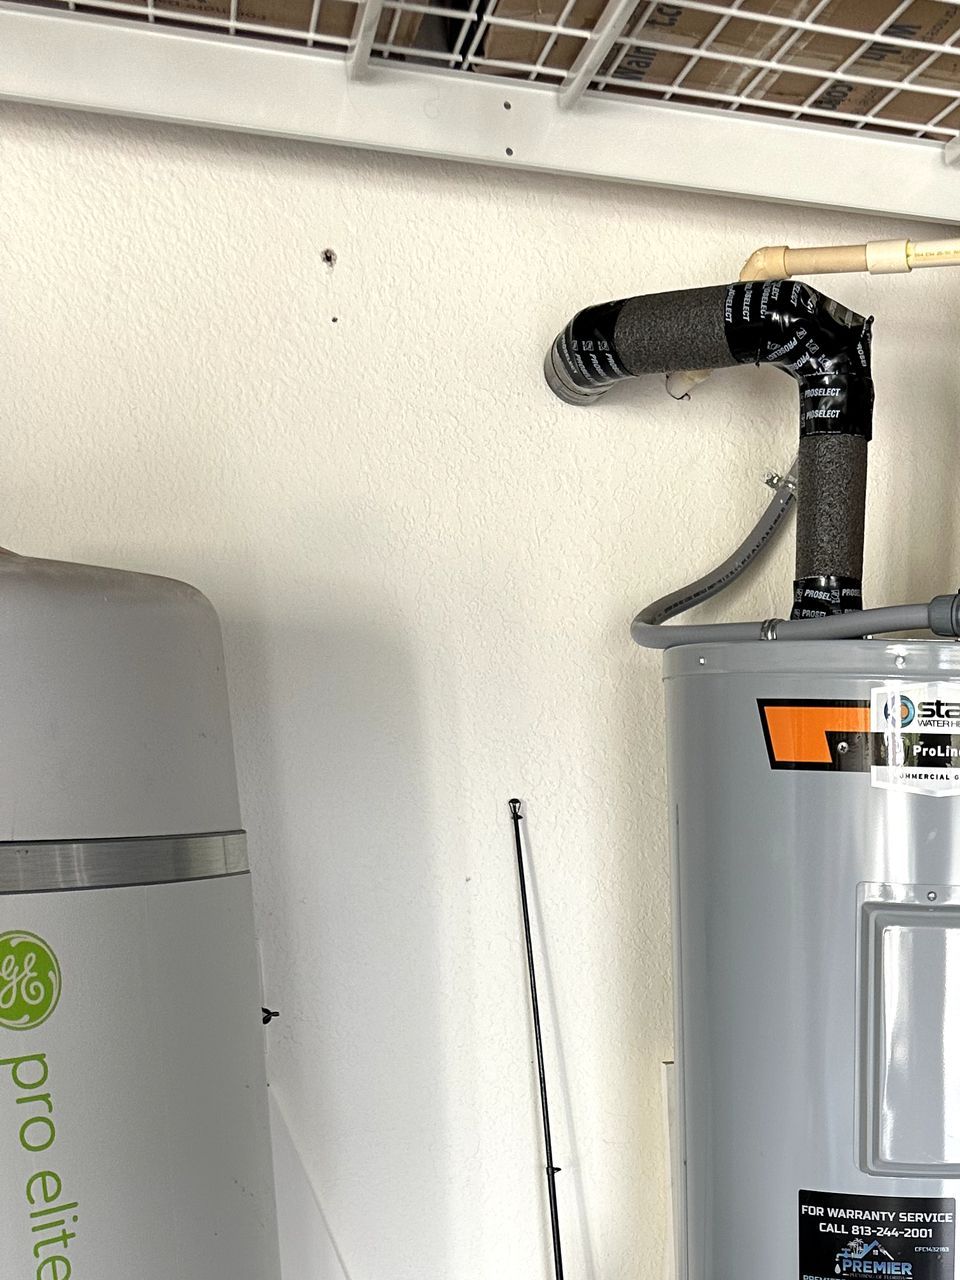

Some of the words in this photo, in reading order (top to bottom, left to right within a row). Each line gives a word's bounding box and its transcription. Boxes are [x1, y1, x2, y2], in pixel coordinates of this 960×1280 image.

[805, 388, 841, 398] PROSELECT
[0, 1052, 53, 1153] pro
[801, 1205, 824, 1217] FOR
[827, 1208, 896, 1222] WARRANTY
[899, 1212, 953, 1223] SERVICE
[819, 1222, 848, 1235] CALL
[851, 1226, 933, 1238] 813-244-2001
[842, 1259, 913, 1276] PREMIER
